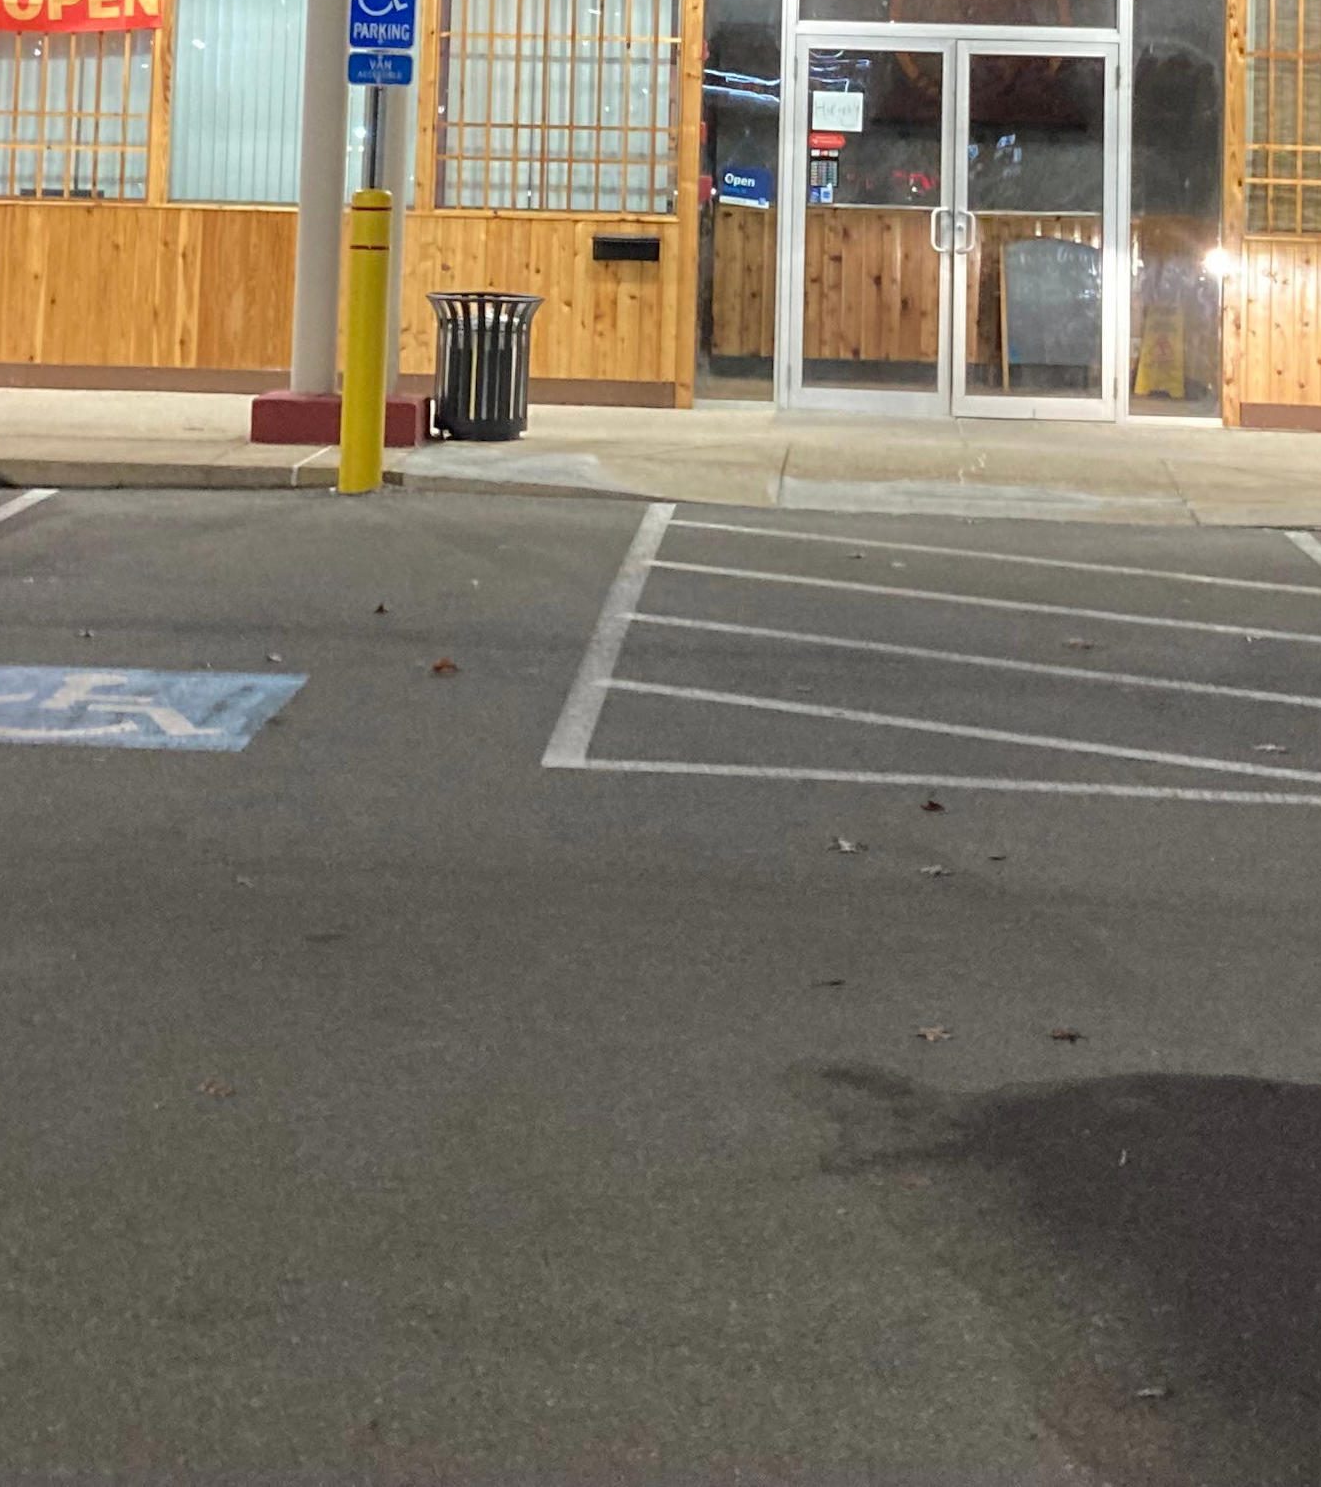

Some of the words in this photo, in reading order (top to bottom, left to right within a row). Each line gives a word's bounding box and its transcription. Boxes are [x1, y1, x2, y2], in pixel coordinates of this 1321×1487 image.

[353, 22, 410, 41] PARKING
[369, 59, 392, 70] VAN
[724, 172, 755, 188] Open
